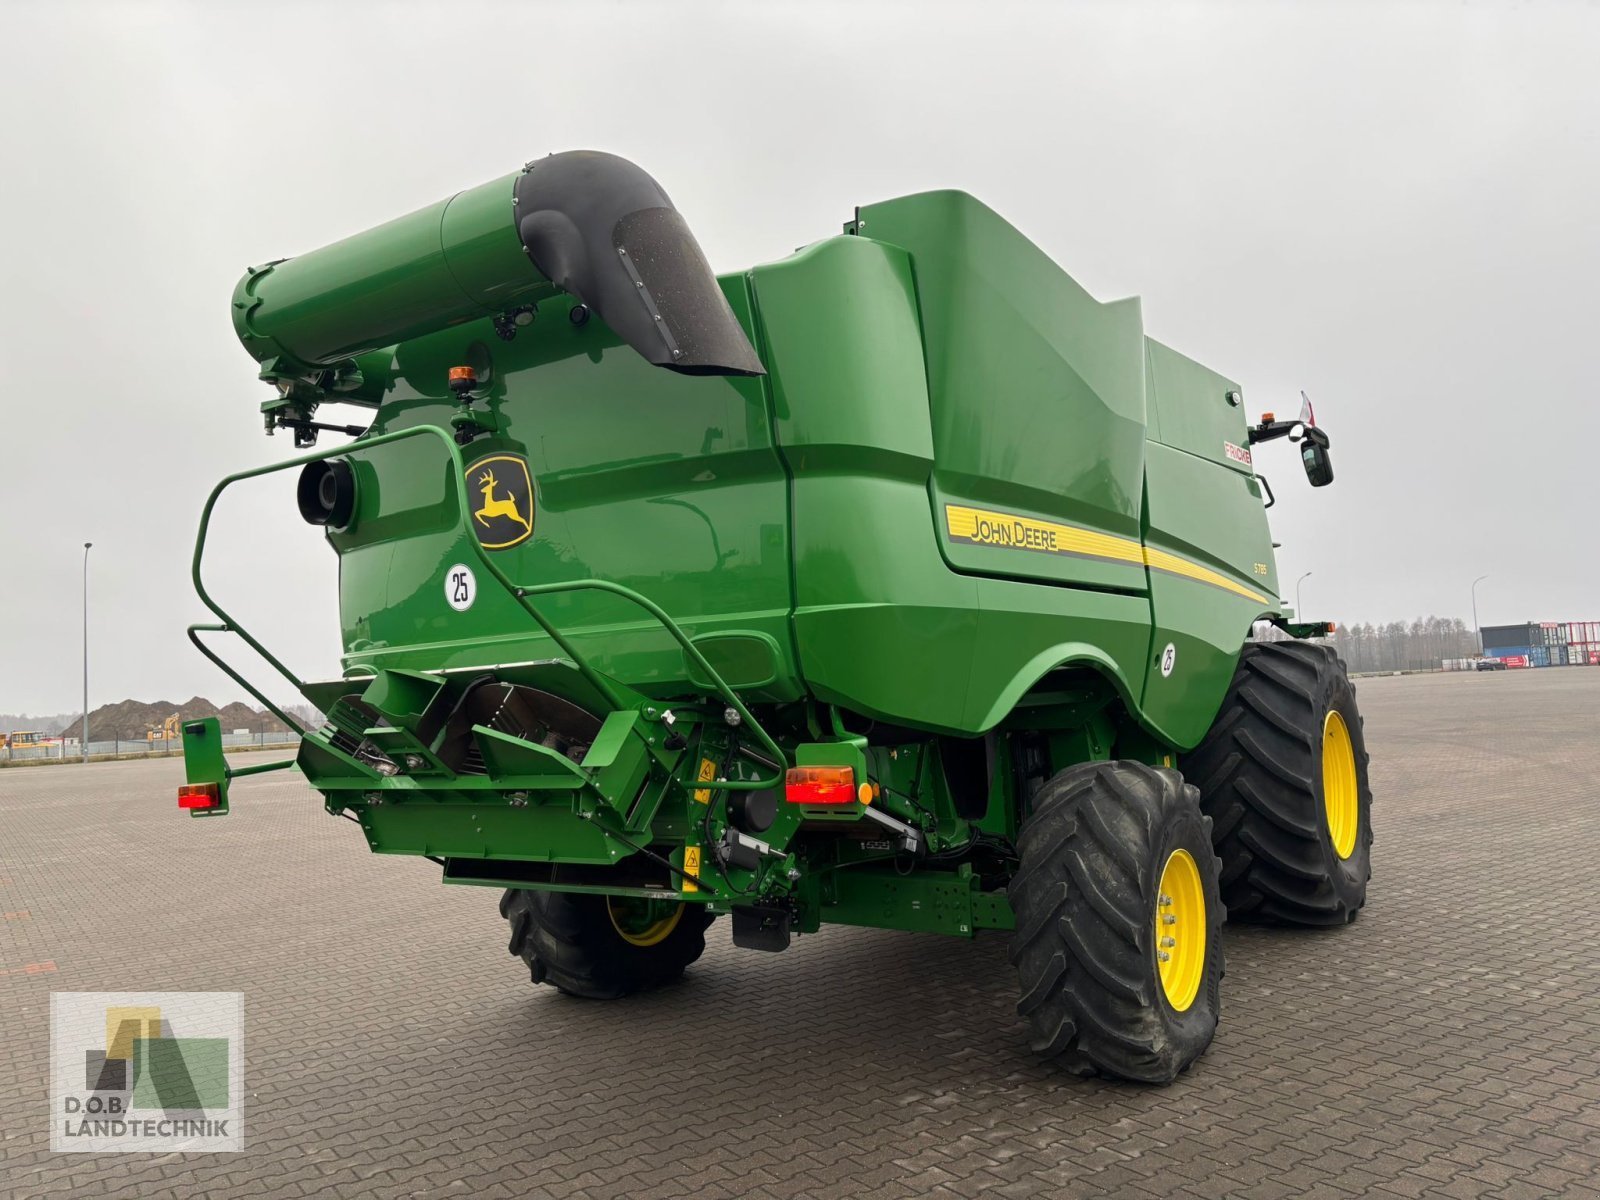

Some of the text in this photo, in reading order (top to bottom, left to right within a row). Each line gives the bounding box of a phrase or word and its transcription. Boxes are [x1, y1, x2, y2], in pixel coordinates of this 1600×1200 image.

[1225, 442, 1251, 464] FRICKE
[971, 515, 1059, 549] JOHN DEERE
[452, 572, 469, 603] 25
[1164, 649, 1173, 671] 25
